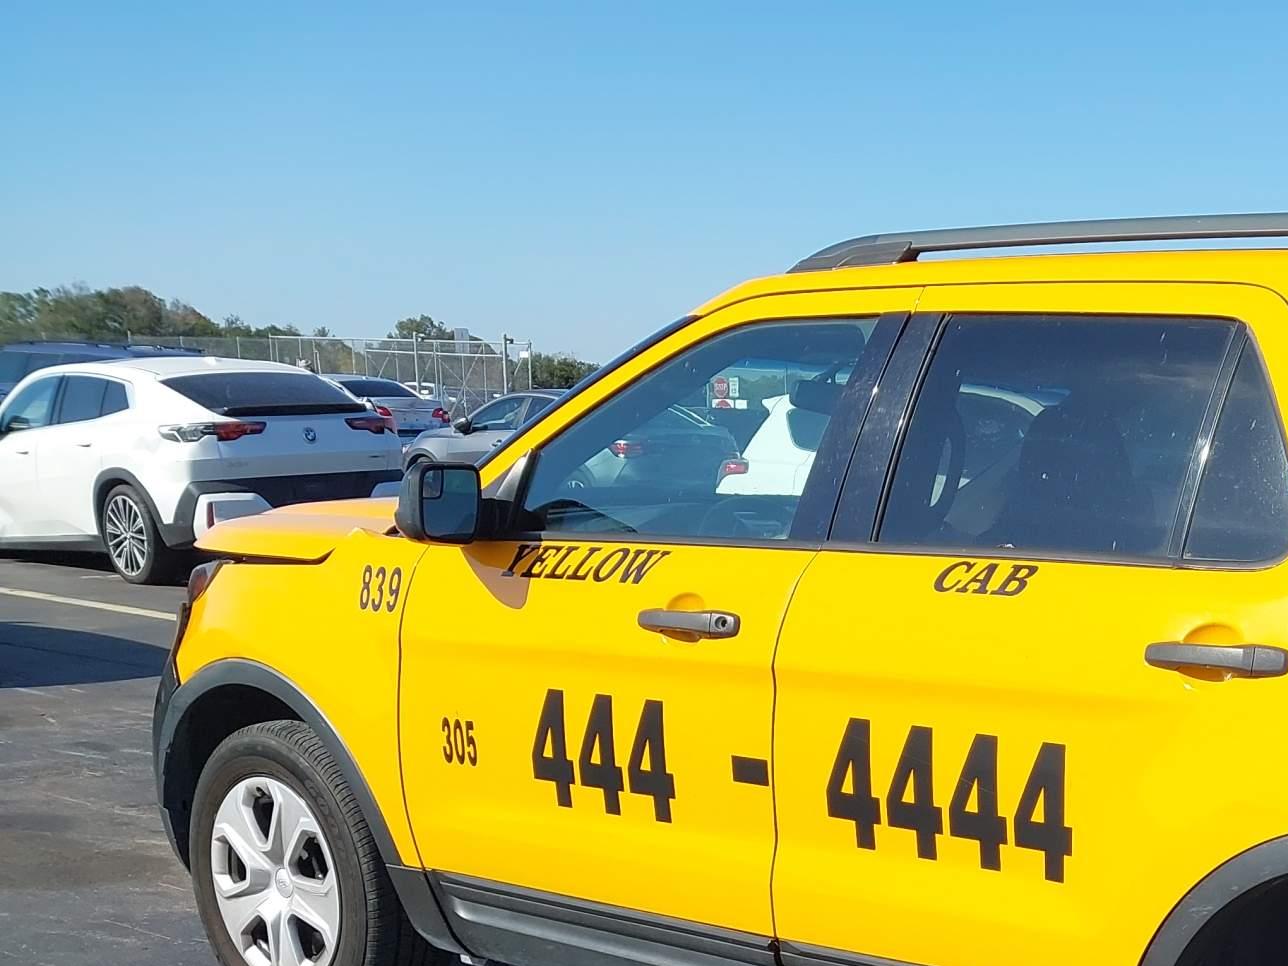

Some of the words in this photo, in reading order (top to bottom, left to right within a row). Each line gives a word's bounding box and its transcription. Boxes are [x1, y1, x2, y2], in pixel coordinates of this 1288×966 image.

[501, 544, 672, 585] YELLOW
[934, 561, 1038, 597] CAB
[360, 565, 402, 613] 839
[442, 717, 477, 767] 305
[532, 688, 675, 824] 444
[826, 717, 1073, 884] 4444
